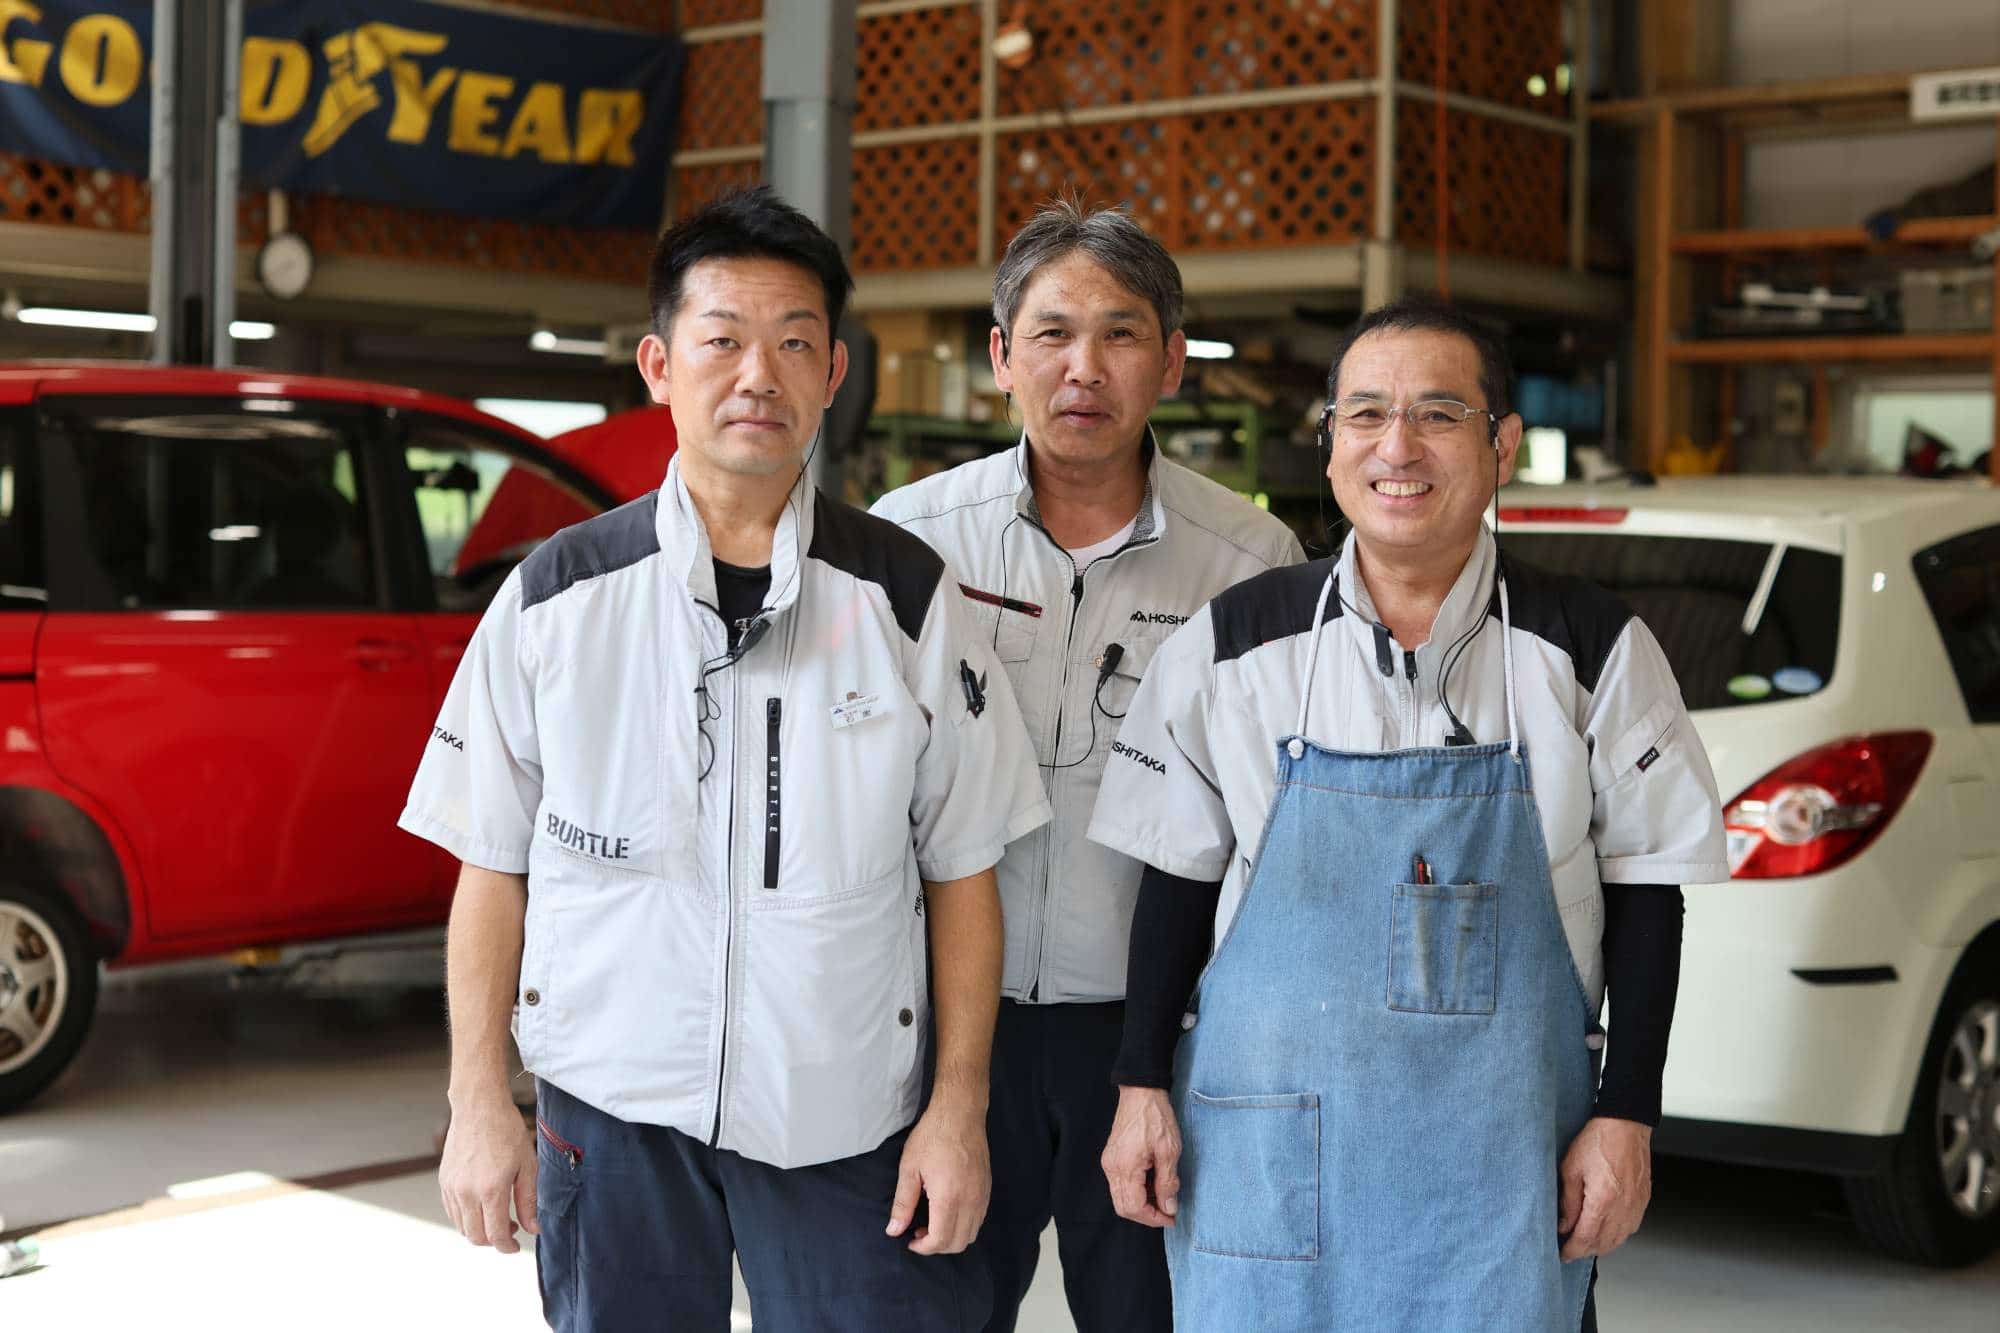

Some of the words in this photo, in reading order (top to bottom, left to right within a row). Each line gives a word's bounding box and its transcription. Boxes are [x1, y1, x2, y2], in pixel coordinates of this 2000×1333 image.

[0, 0, 643, 166] GODYEAR
[1111, 741, 1166, 775] SHITAKA
[769, 755, 779, 833] BURTLE
[546, 812, 631, 859] BURTLE
